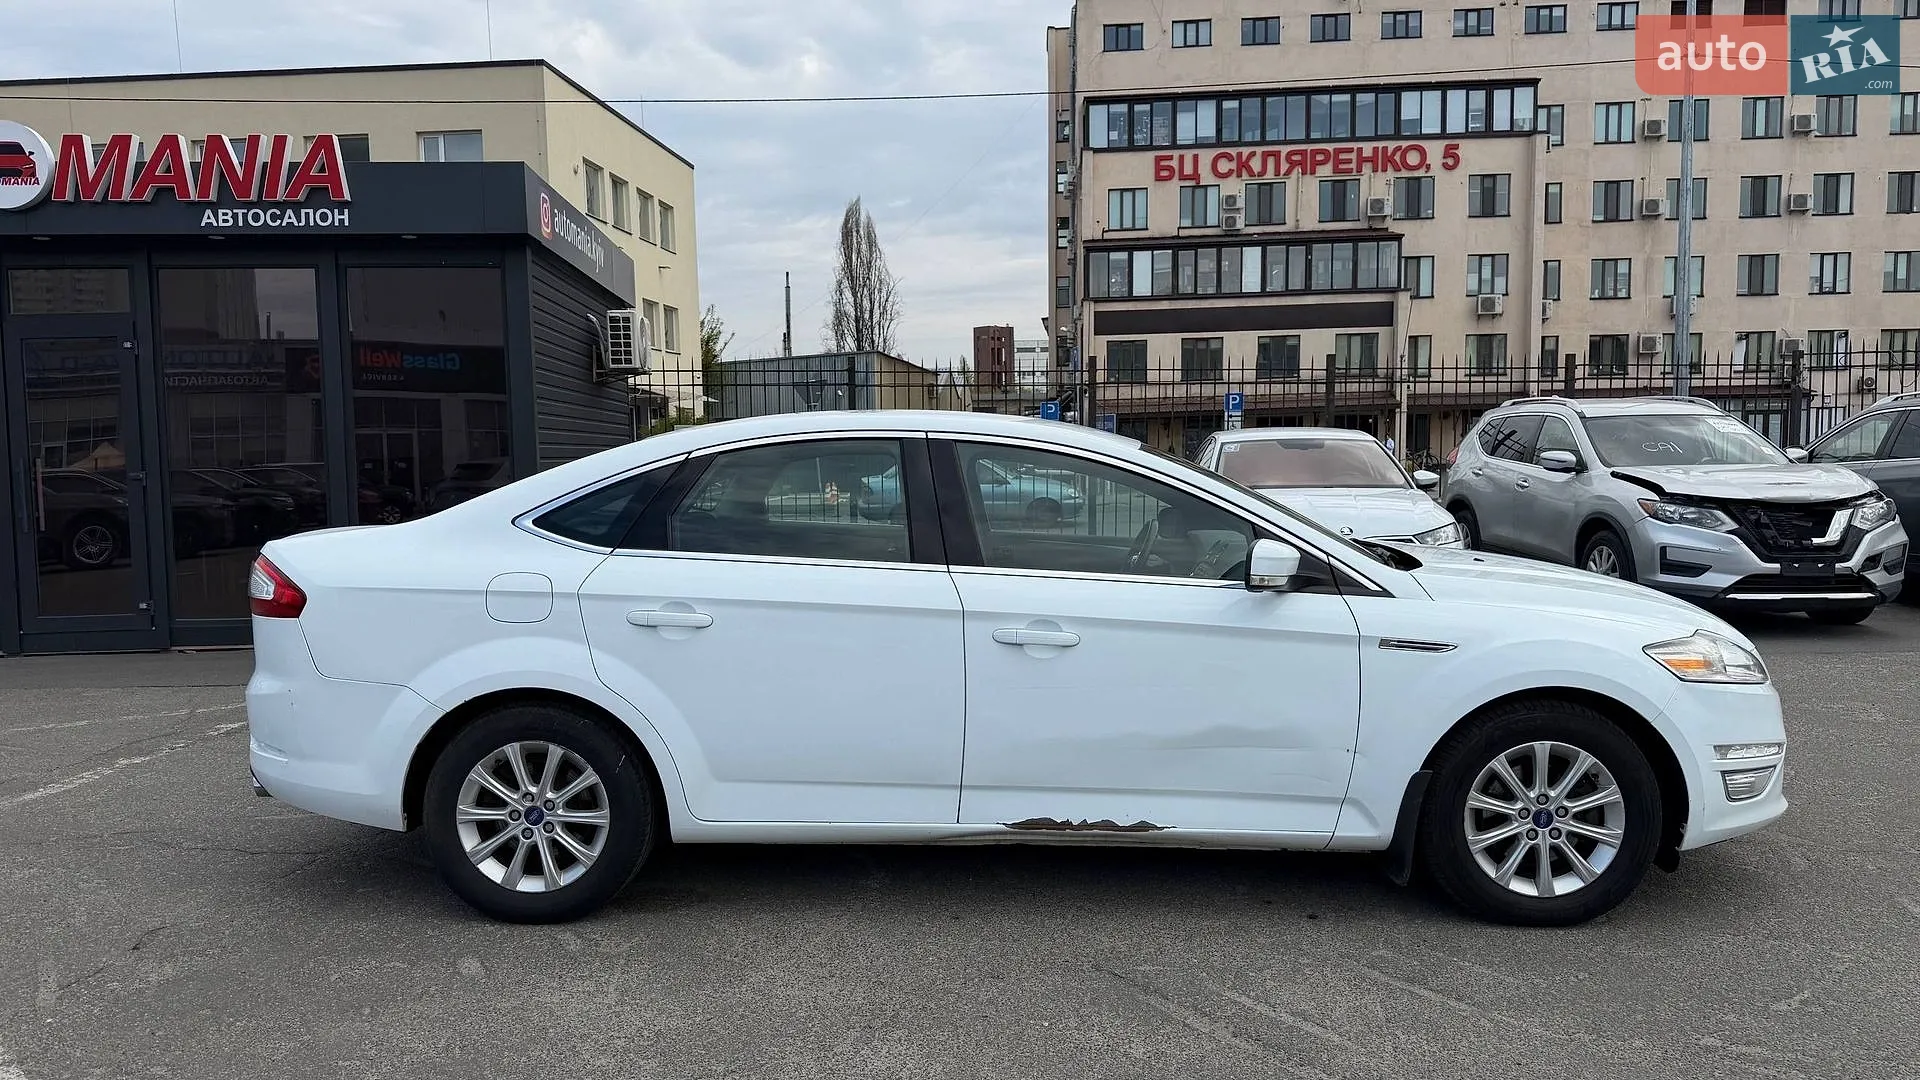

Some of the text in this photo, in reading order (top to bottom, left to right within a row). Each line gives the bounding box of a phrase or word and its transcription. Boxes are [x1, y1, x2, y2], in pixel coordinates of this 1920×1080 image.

[52, 133, 351, 202] MANIA
[1154, 143, 1461, 184] БЦ СКЛЯРЕНКО, 5
[0, 176, 40, 186] MANIA
[200, 208, 350, 228] АВТОСАЛОН
[554, 208, 605, 273] automania.kyiv
[1229, 394, 1239, 410] P
